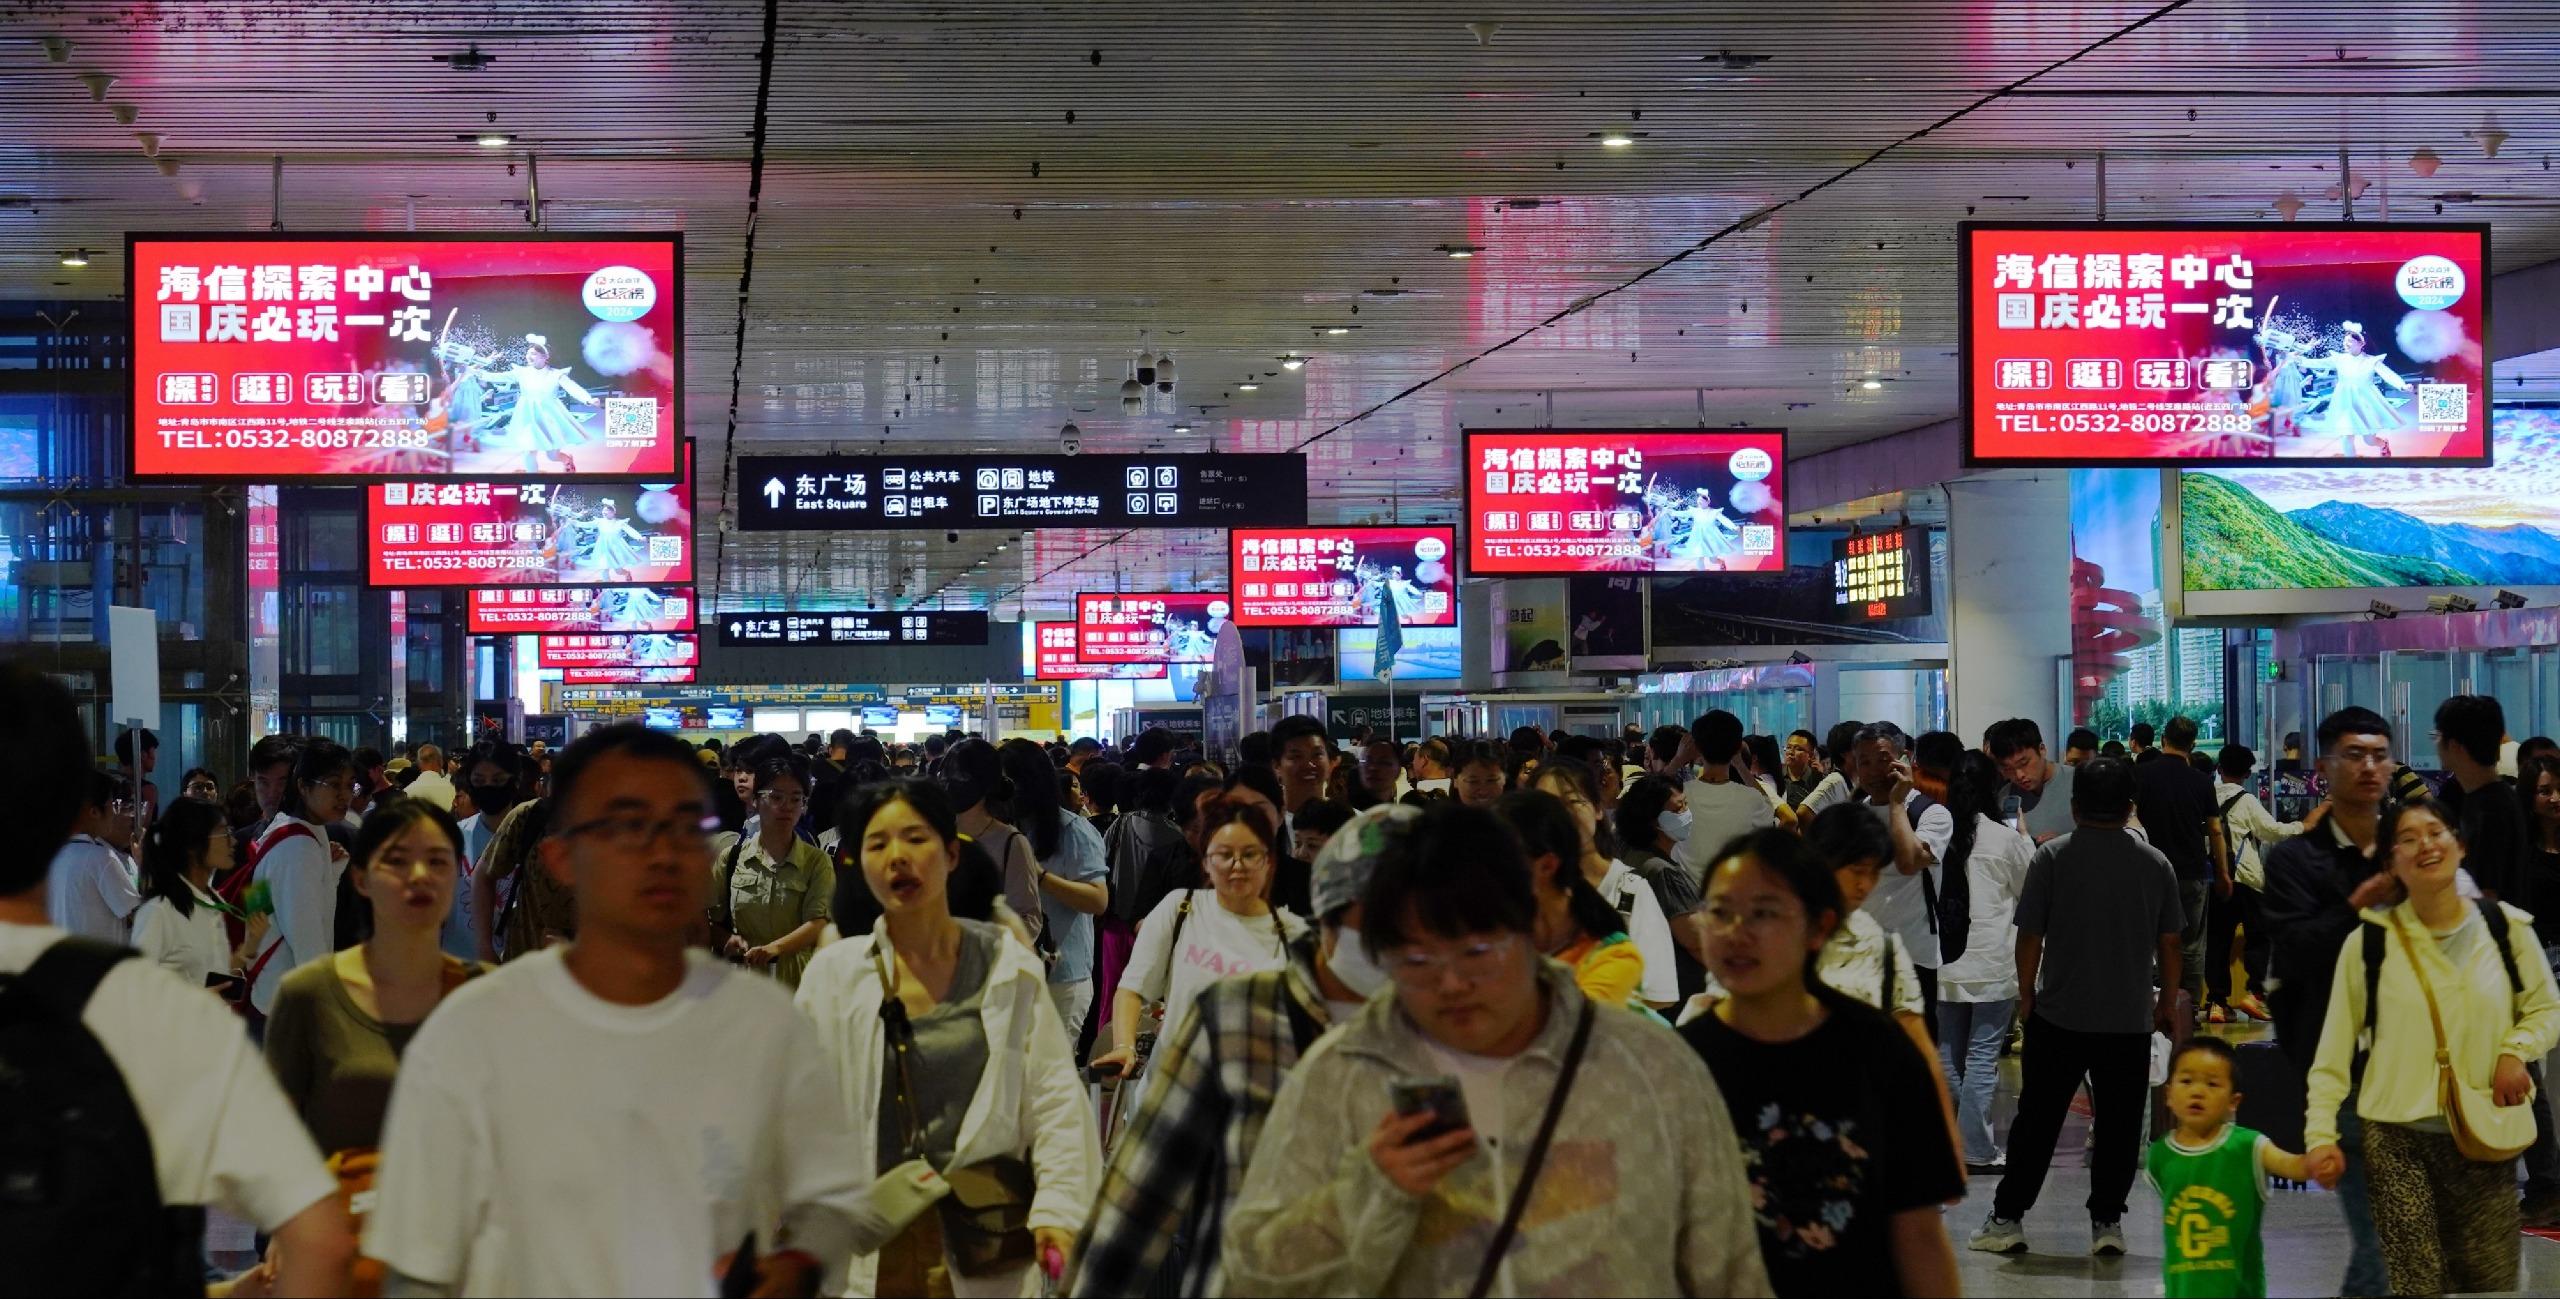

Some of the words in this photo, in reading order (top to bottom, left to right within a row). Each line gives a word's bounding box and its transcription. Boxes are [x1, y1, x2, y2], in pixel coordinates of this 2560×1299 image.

[1994, 253, 2253, 290] 海信探索中心
[157, 265, 432, 301] 海信探索中心
[2418, 295, 2445, 305] 2024
[1998, 293, 2253, 330] 国庆必玩一次
[161, 304, 432, 342] 国庆必玩一次
[2001, 361, 2033, 388] 探
[2072, 361, 2103, 388] 逛
[2140, 361, 2171, 388] 玩
[2205, 361, 2234, 388] 看
[165, 375, 197, 402] 探
[239, 375, 271, 402] 逛
[311, 376, 344, 402] 玩
[380, 375, 410, 402] 看
[1995, 413, 2253, 433] TEL:0532-80872888
[158, 428, 430, 448] TEL:0532-80872888
[1483, 448, 1642, 470] 海信探索中心
[796, 474, 867, 496] 东广场
[910, 470, 961, 483] 公共汽车
[1028, 470, 1055, 482] 地铁
[1486, 472, 1642, 494] 国庆必玩一次
[384, 484, 546, 505] 国庆必玩一次
[911, 497, 948, 509] 出租车
[1003, 496, 1100, 509] 东广场地下停车场
[796, 498, 823, 510] East
[827, 499, 867, 511] Square
[1074, 507, 1098, 515] Parking
[1572, 512, 1593, 530] 玩
[473, 524, 491, 541] 玩
[1485, 544, 1643, 557] TEL:0532-80872888
[383, 556, 546, 570] TEL:0532-80872888
[1243, 554, 1355, 572] 国庆必玩一次
[479, 612, 593, 623] TEL:0532-80872888
[1243, 606, 1355, 616] TEL:0532-80872888
[746, 620, 780, 632] 东广场
